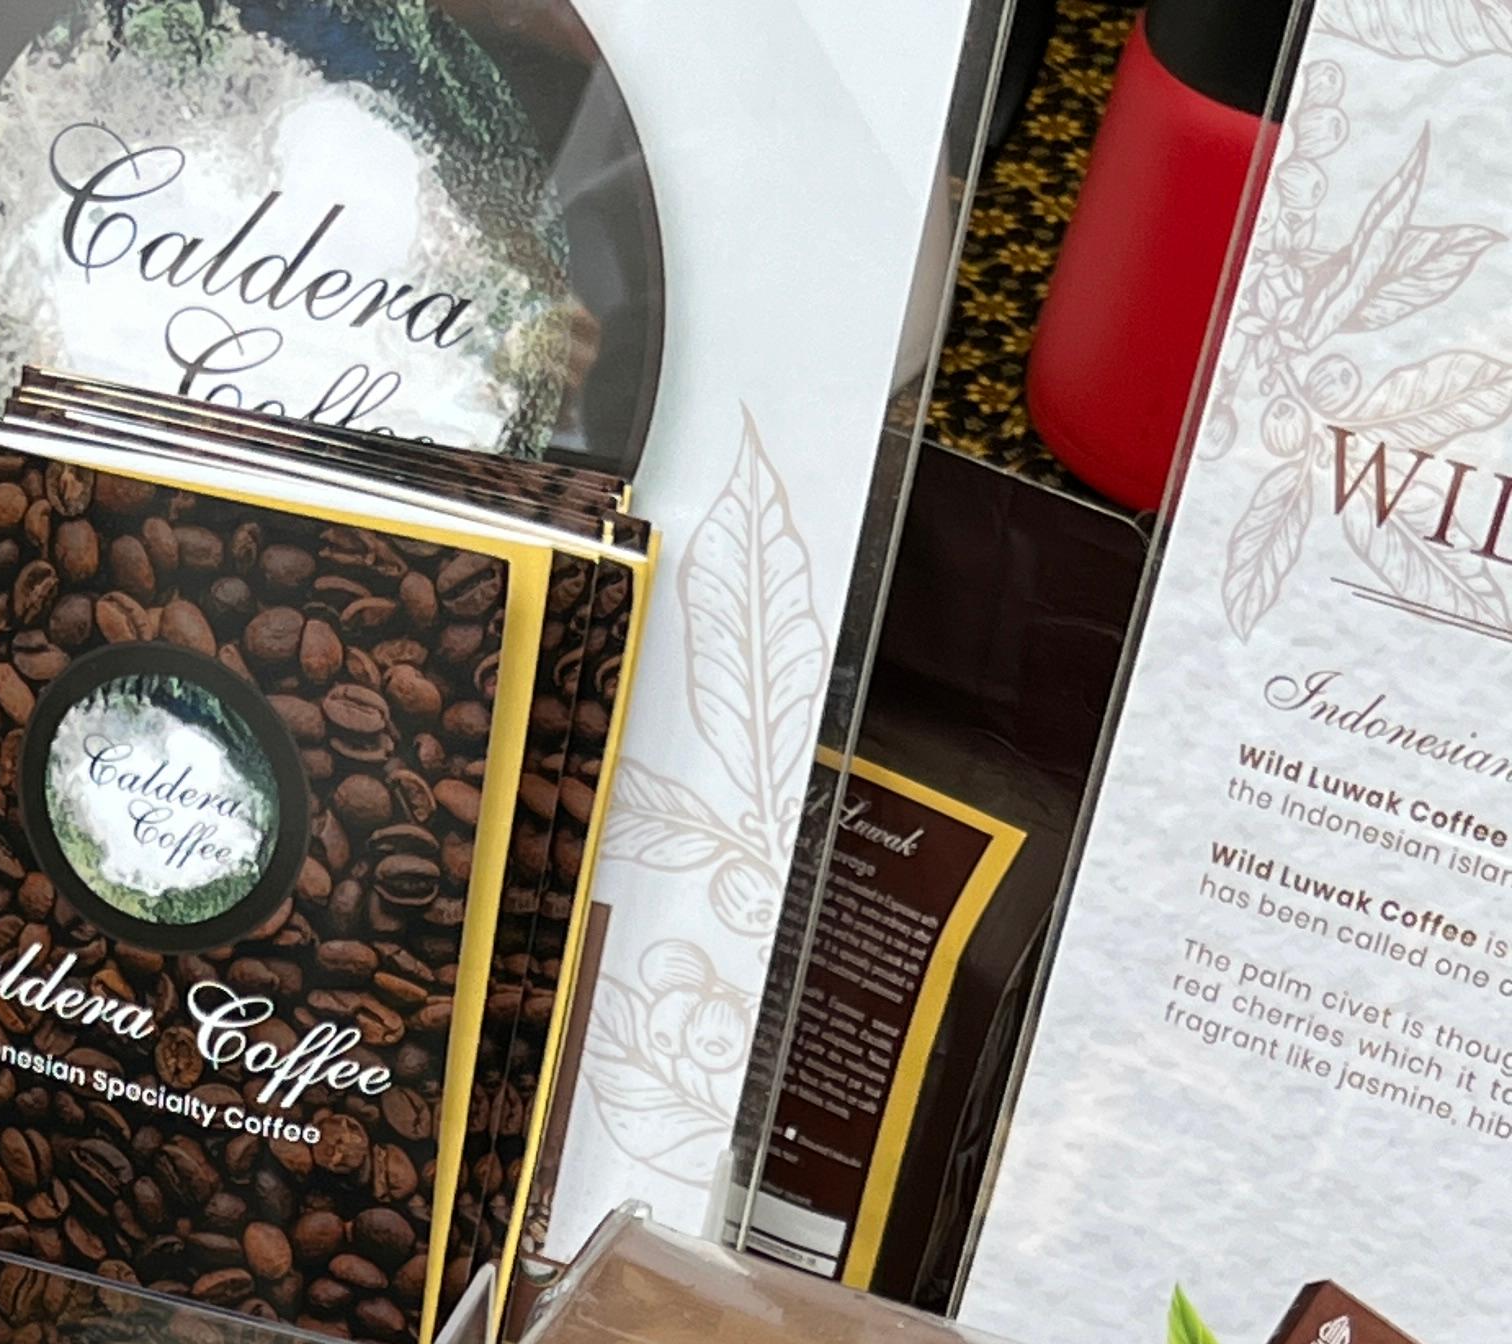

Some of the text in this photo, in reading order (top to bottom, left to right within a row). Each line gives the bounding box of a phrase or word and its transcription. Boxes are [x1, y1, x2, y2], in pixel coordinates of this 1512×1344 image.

[49, 122, 474, 349] Caldera
[83, 733, 239, 819] Caldera
[1227, 775, 1442, 865] the Indonesian
[1238, 742, 1507, 848] Wild Luwak Coffee
[128, 799, 232, 868] Coffee
[1198, 871, 1490, 988] has been called one
[1210, 840, 1510, 960] Wild Luwak Coffee is
[1171, 973, 1477, 1098] red cherries which it
[1184, 937, 1231, 973] The
[1236, 961, 1312, 1002] palm
[1320, 989, 1395, 1030] civet
[1400, 1011, 1424, 1039] is
[187, 980, 392, 1109] Coffee
[1163, 999, 1279, 1061] fragrant
[1284, 1042, 1332, 1078] like
[1333, 1060, 1457, 1126] jasmine,
[93, 1067, 217, 1128] Specialty
[223, 1103, 321, 1145] Coffee
